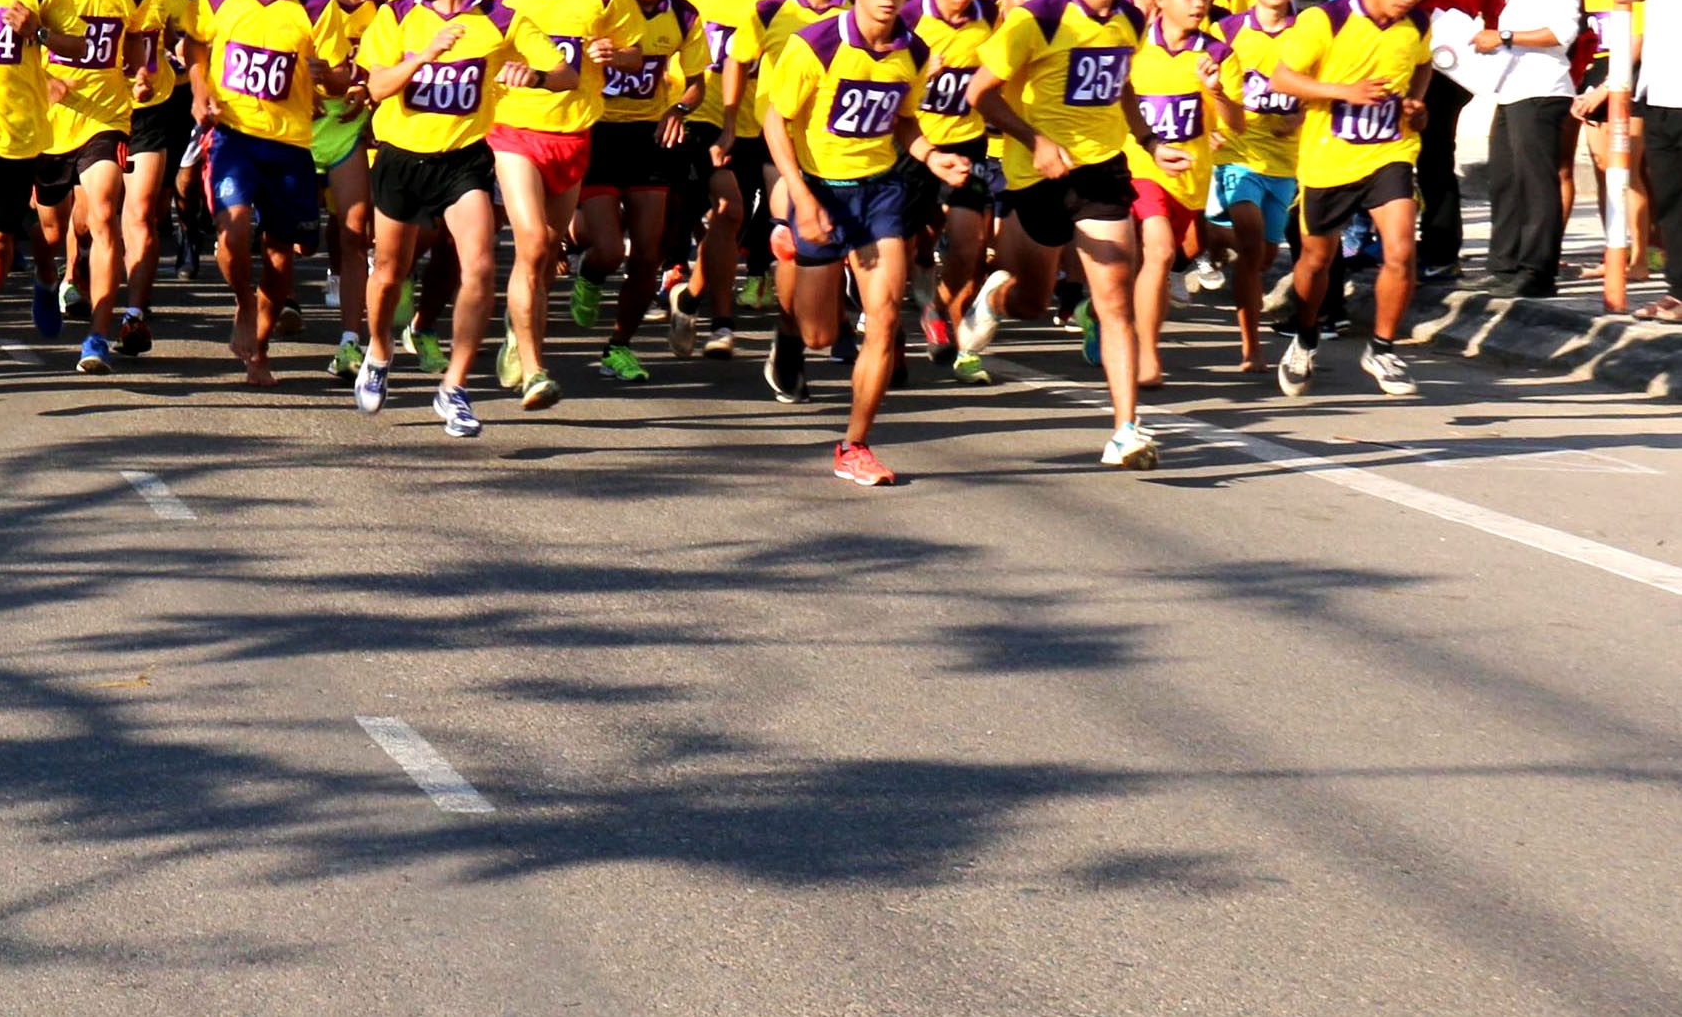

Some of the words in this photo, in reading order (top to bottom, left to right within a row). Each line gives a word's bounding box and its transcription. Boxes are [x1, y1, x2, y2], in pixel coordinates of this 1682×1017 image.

[225, 48, 286, 96] 256
[411, 64, 478, 110] 266
[834, 88, 901, 133] 272
[1338, 100, 1396, 140] 102
